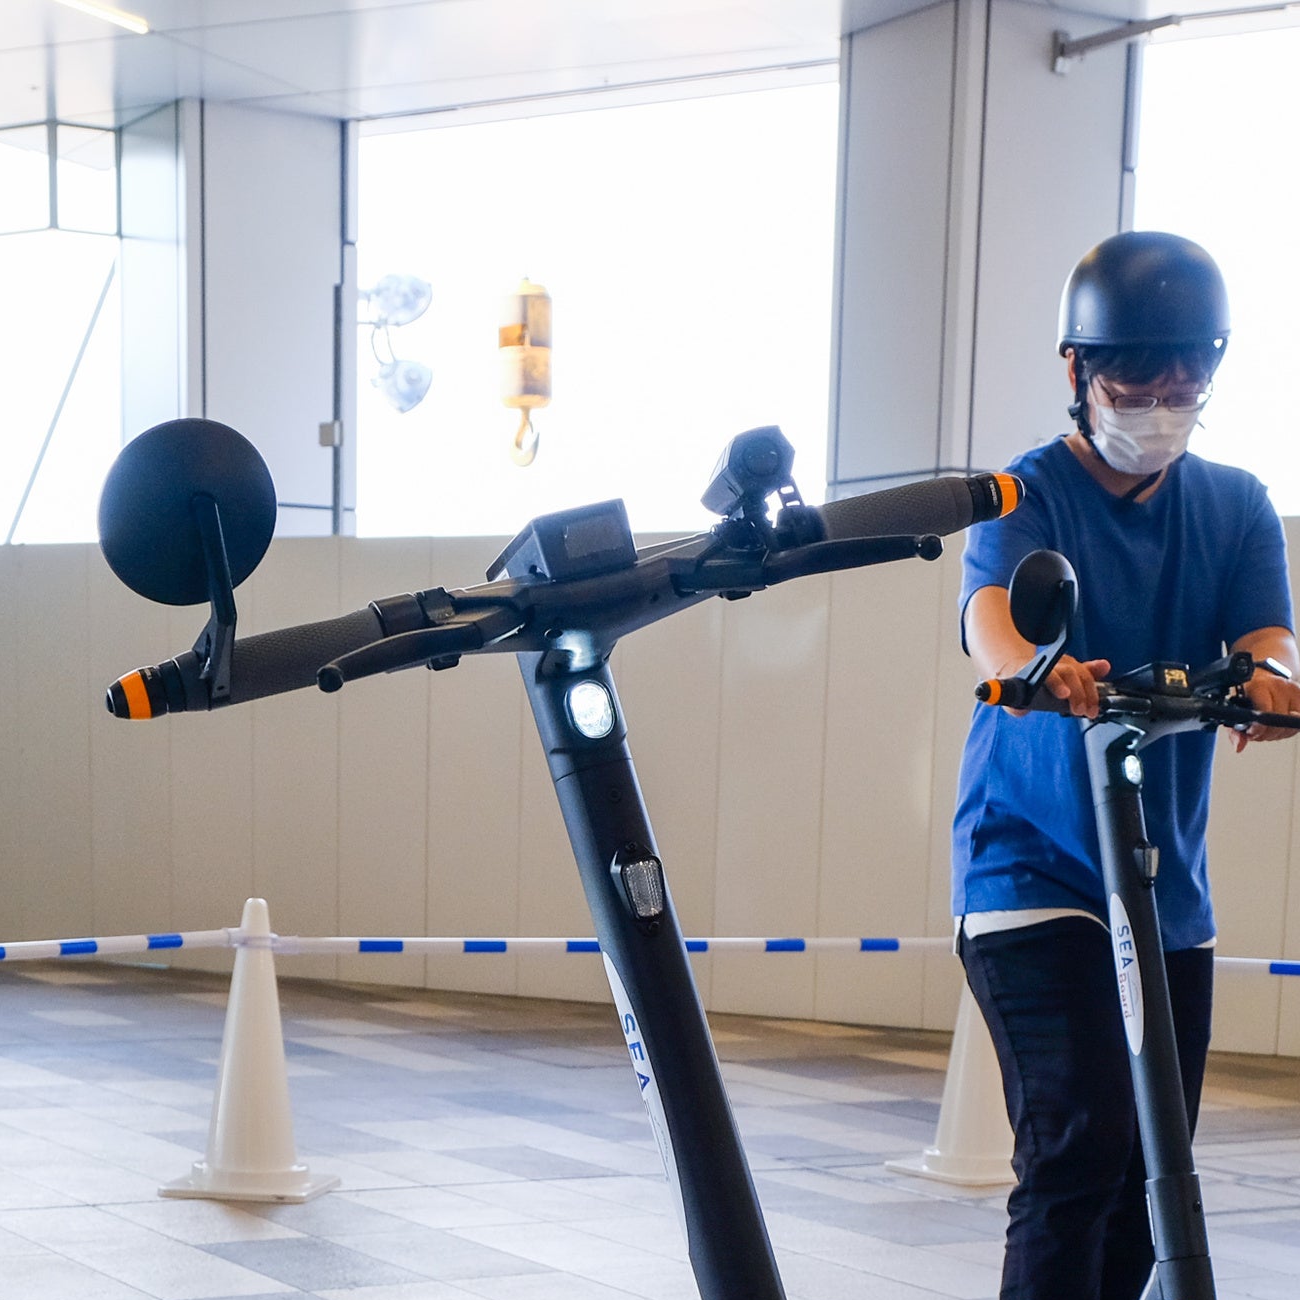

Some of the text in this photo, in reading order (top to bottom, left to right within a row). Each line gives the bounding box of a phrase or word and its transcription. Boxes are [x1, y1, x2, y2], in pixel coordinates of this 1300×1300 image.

[1116, 924, 1134, 1019] SEA Board
[620, 1012, 651, 1094] SEA
